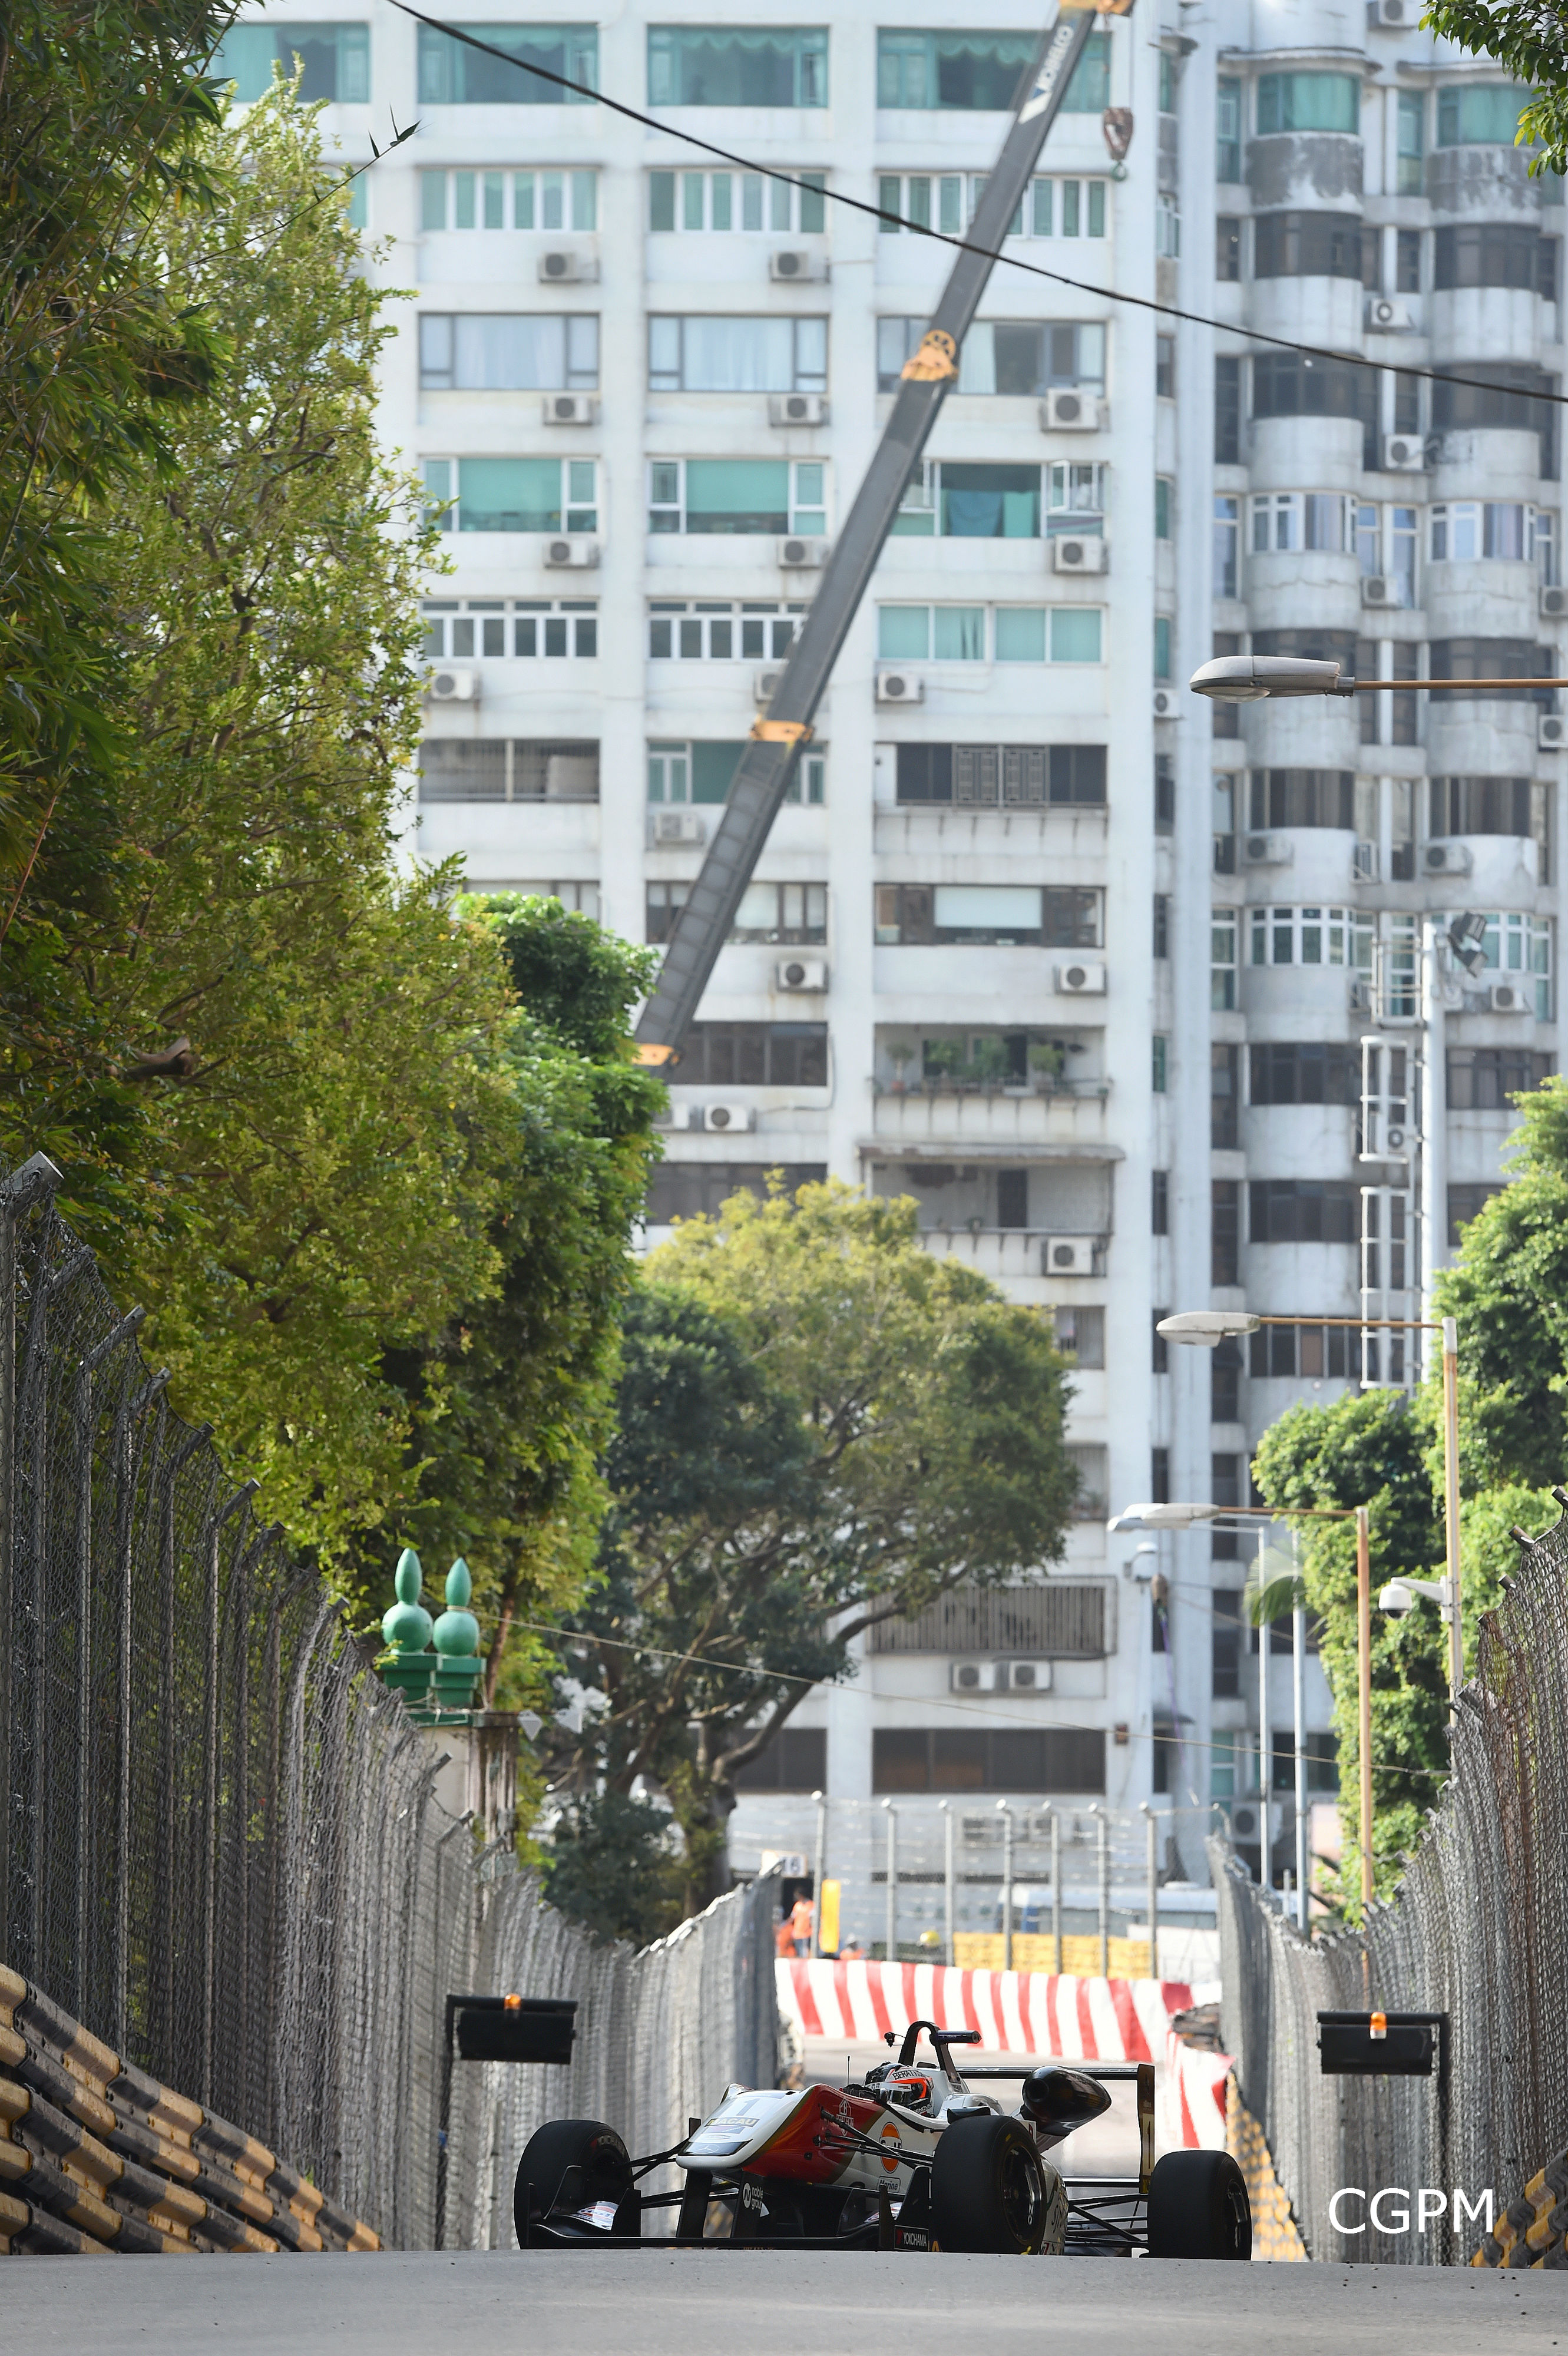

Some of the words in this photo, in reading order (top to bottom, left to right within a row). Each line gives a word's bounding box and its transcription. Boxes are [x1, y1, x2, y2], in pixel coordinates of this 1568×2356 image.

[1036, 25, 1074, 91] KOBELCO
[736, 2099, 760, 2116] 1
[752, 2186, 763, 2199] noble
[904, 2232, 927, 2246] YOKOHAMA
